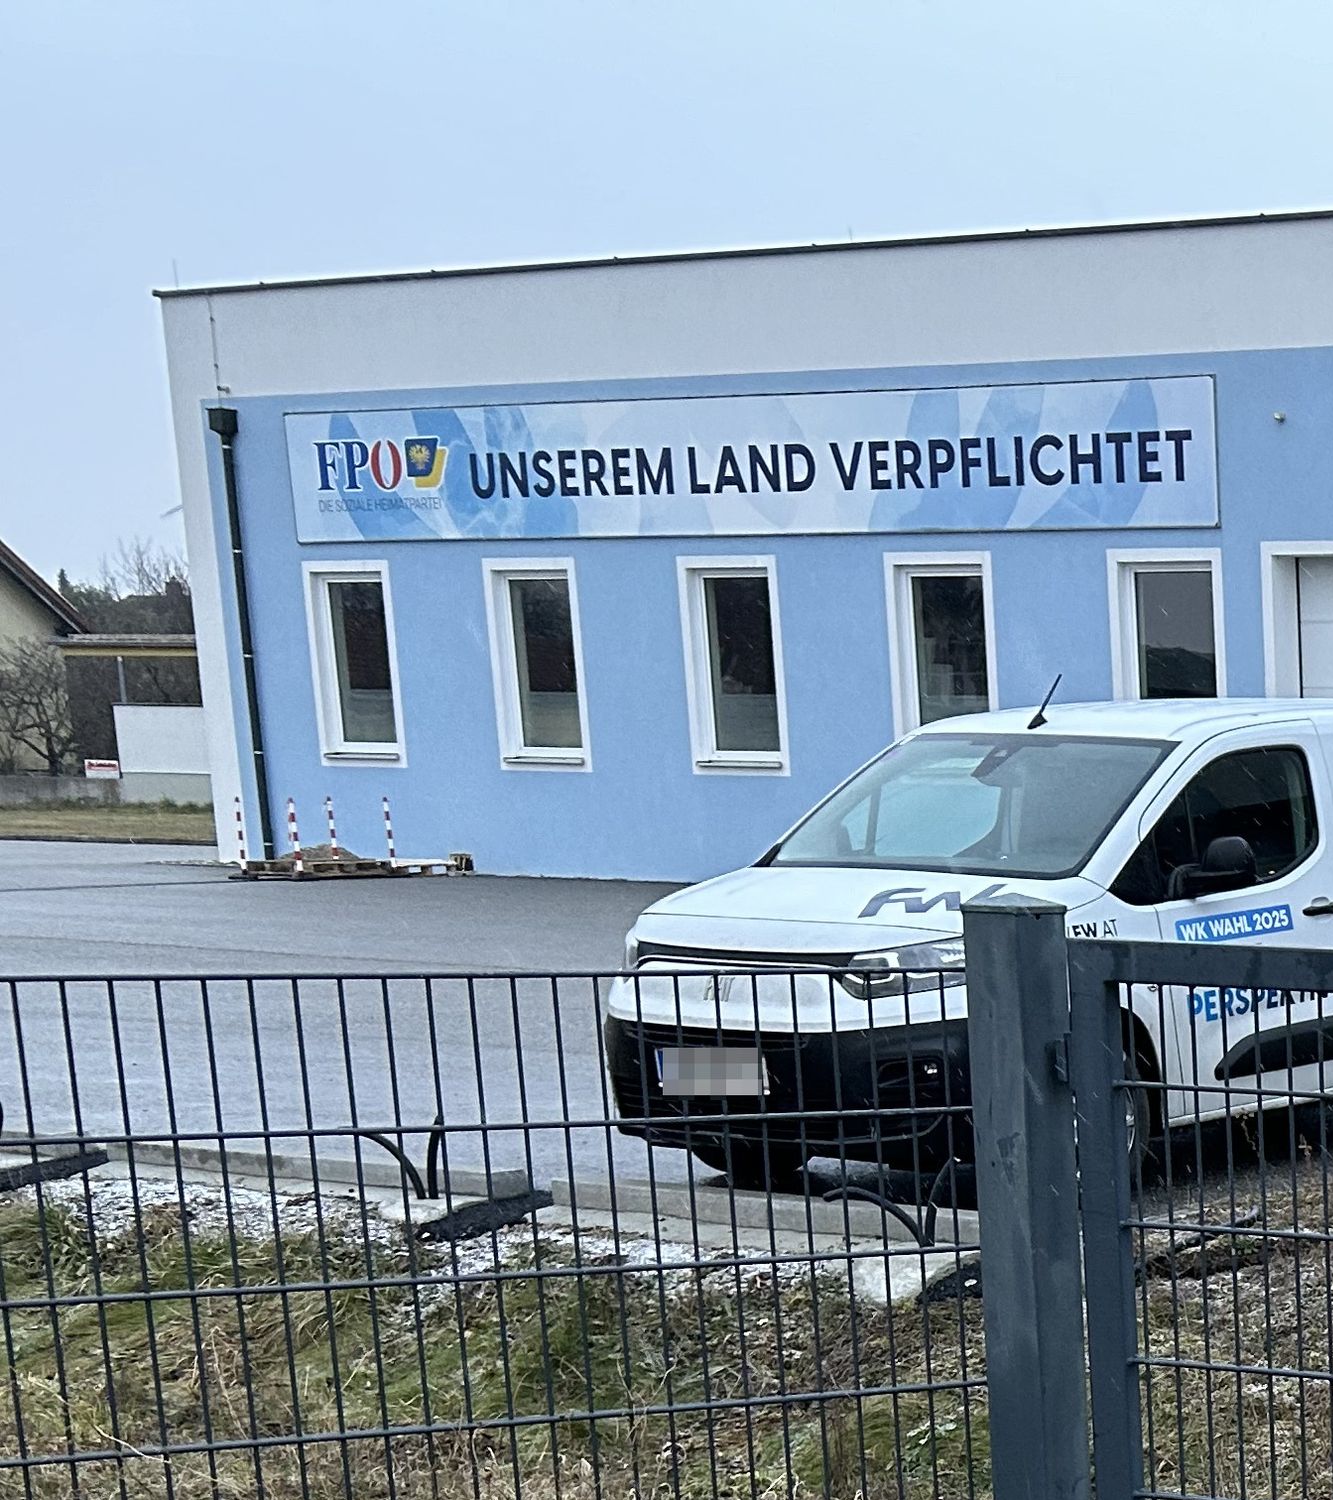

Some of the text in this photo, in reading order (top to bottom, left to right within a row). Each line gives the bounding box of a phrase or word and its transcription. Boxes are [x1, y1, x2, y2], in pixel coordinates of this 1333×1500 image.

[469, 445, 675, 499] UNSEREM
[689, 441, 816, 495] LAND
[829, 430, 1193, 491] VERPFLICHTET
[1179, 909, 1290, 940] WK WAHL 2025
